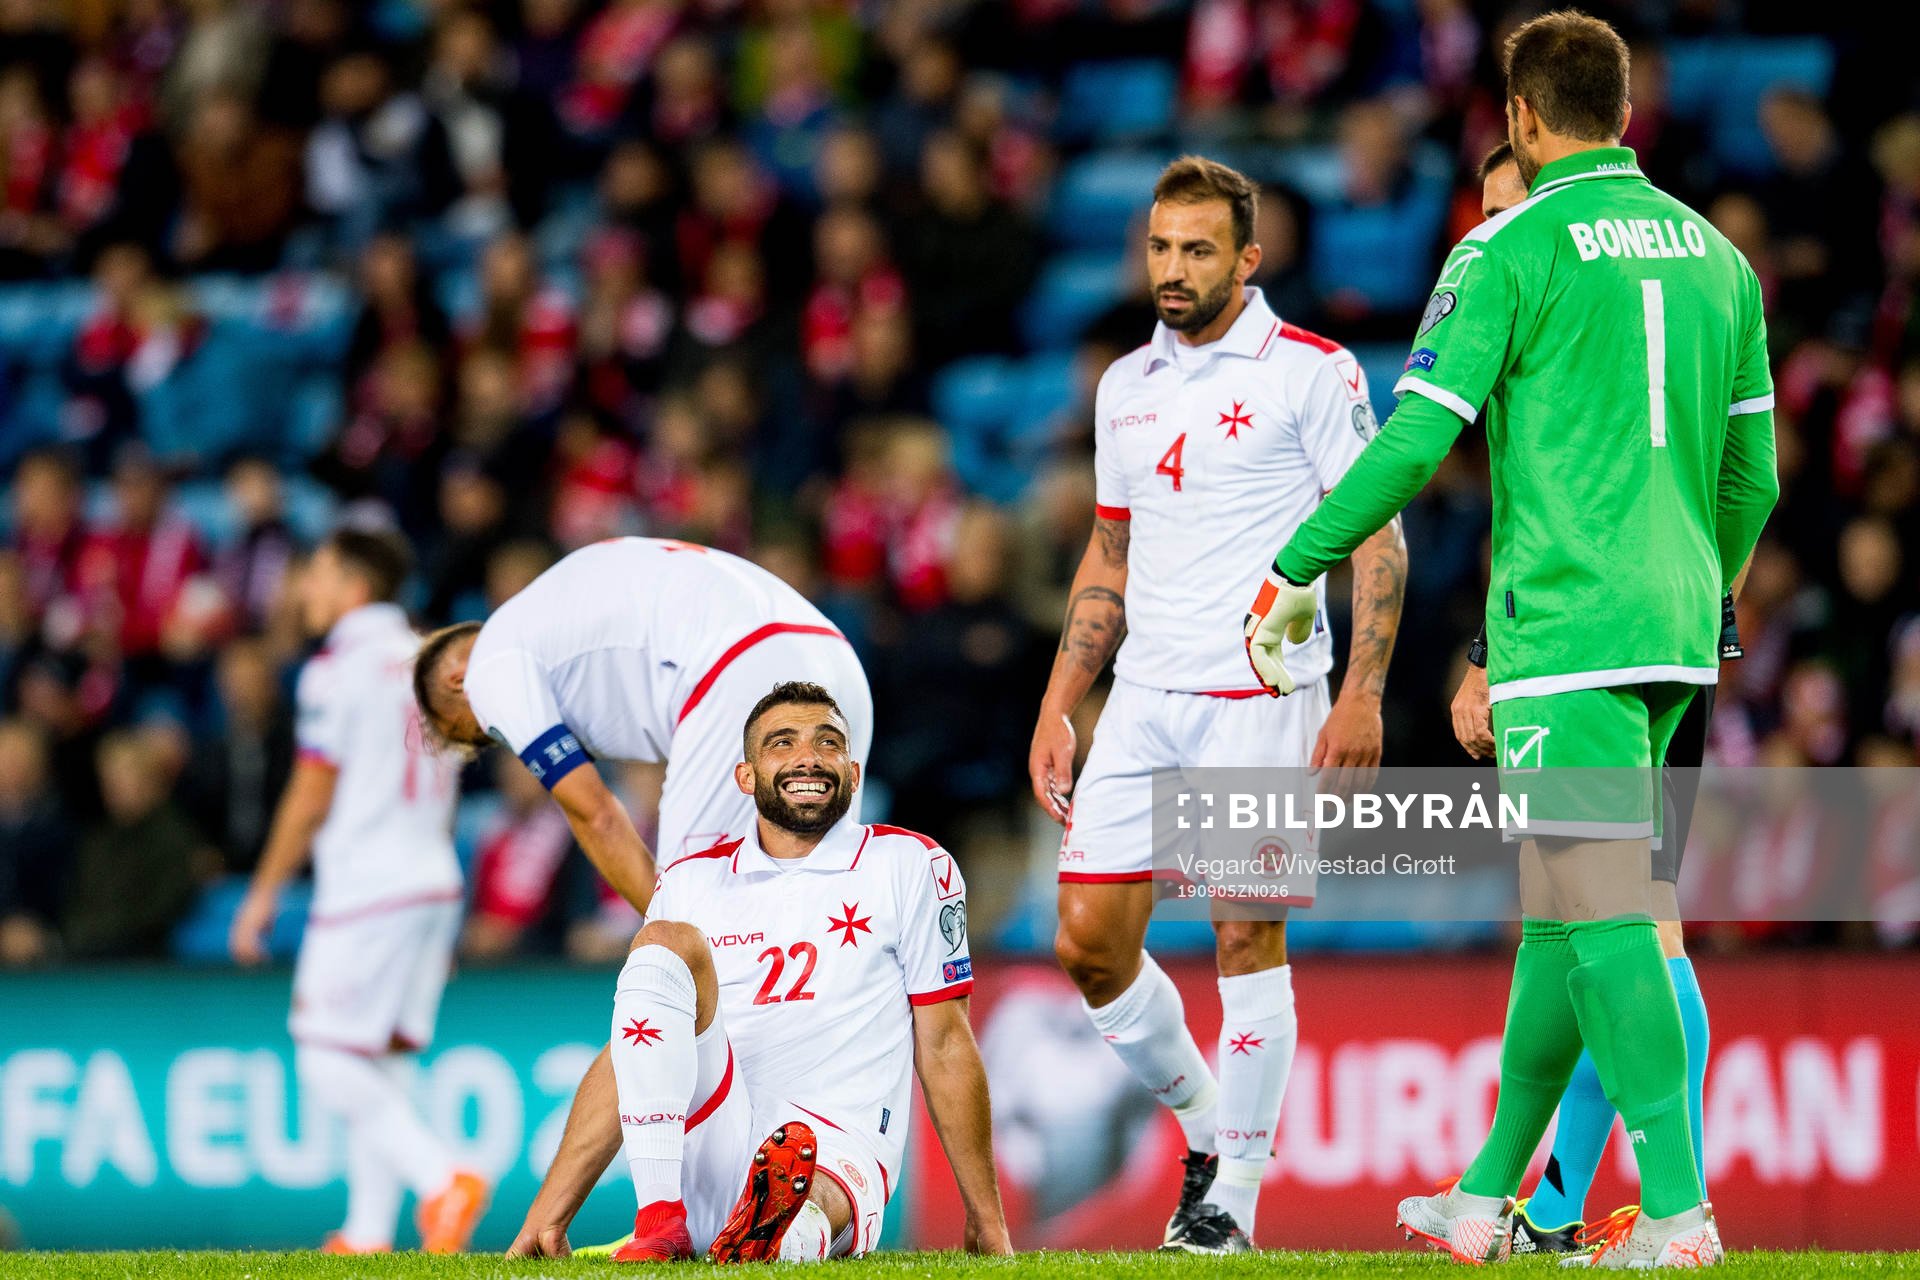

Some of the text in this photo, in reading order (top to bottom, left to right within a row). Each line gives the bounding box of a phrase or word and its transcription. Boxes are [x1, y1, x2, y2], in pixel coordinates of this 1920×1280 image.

[1596, 161, 1633, 171] MALTA
[1567, 218, 1706, 262] BONELLO
[1640, 279, 1667, 448] 1
[1156, 432, 1186, 492] 4
[752, 941, 818, 1006] 22
[164, 1044, 525, 1190] EUO
[1216, 1128, 1268, 1141] VOVA
